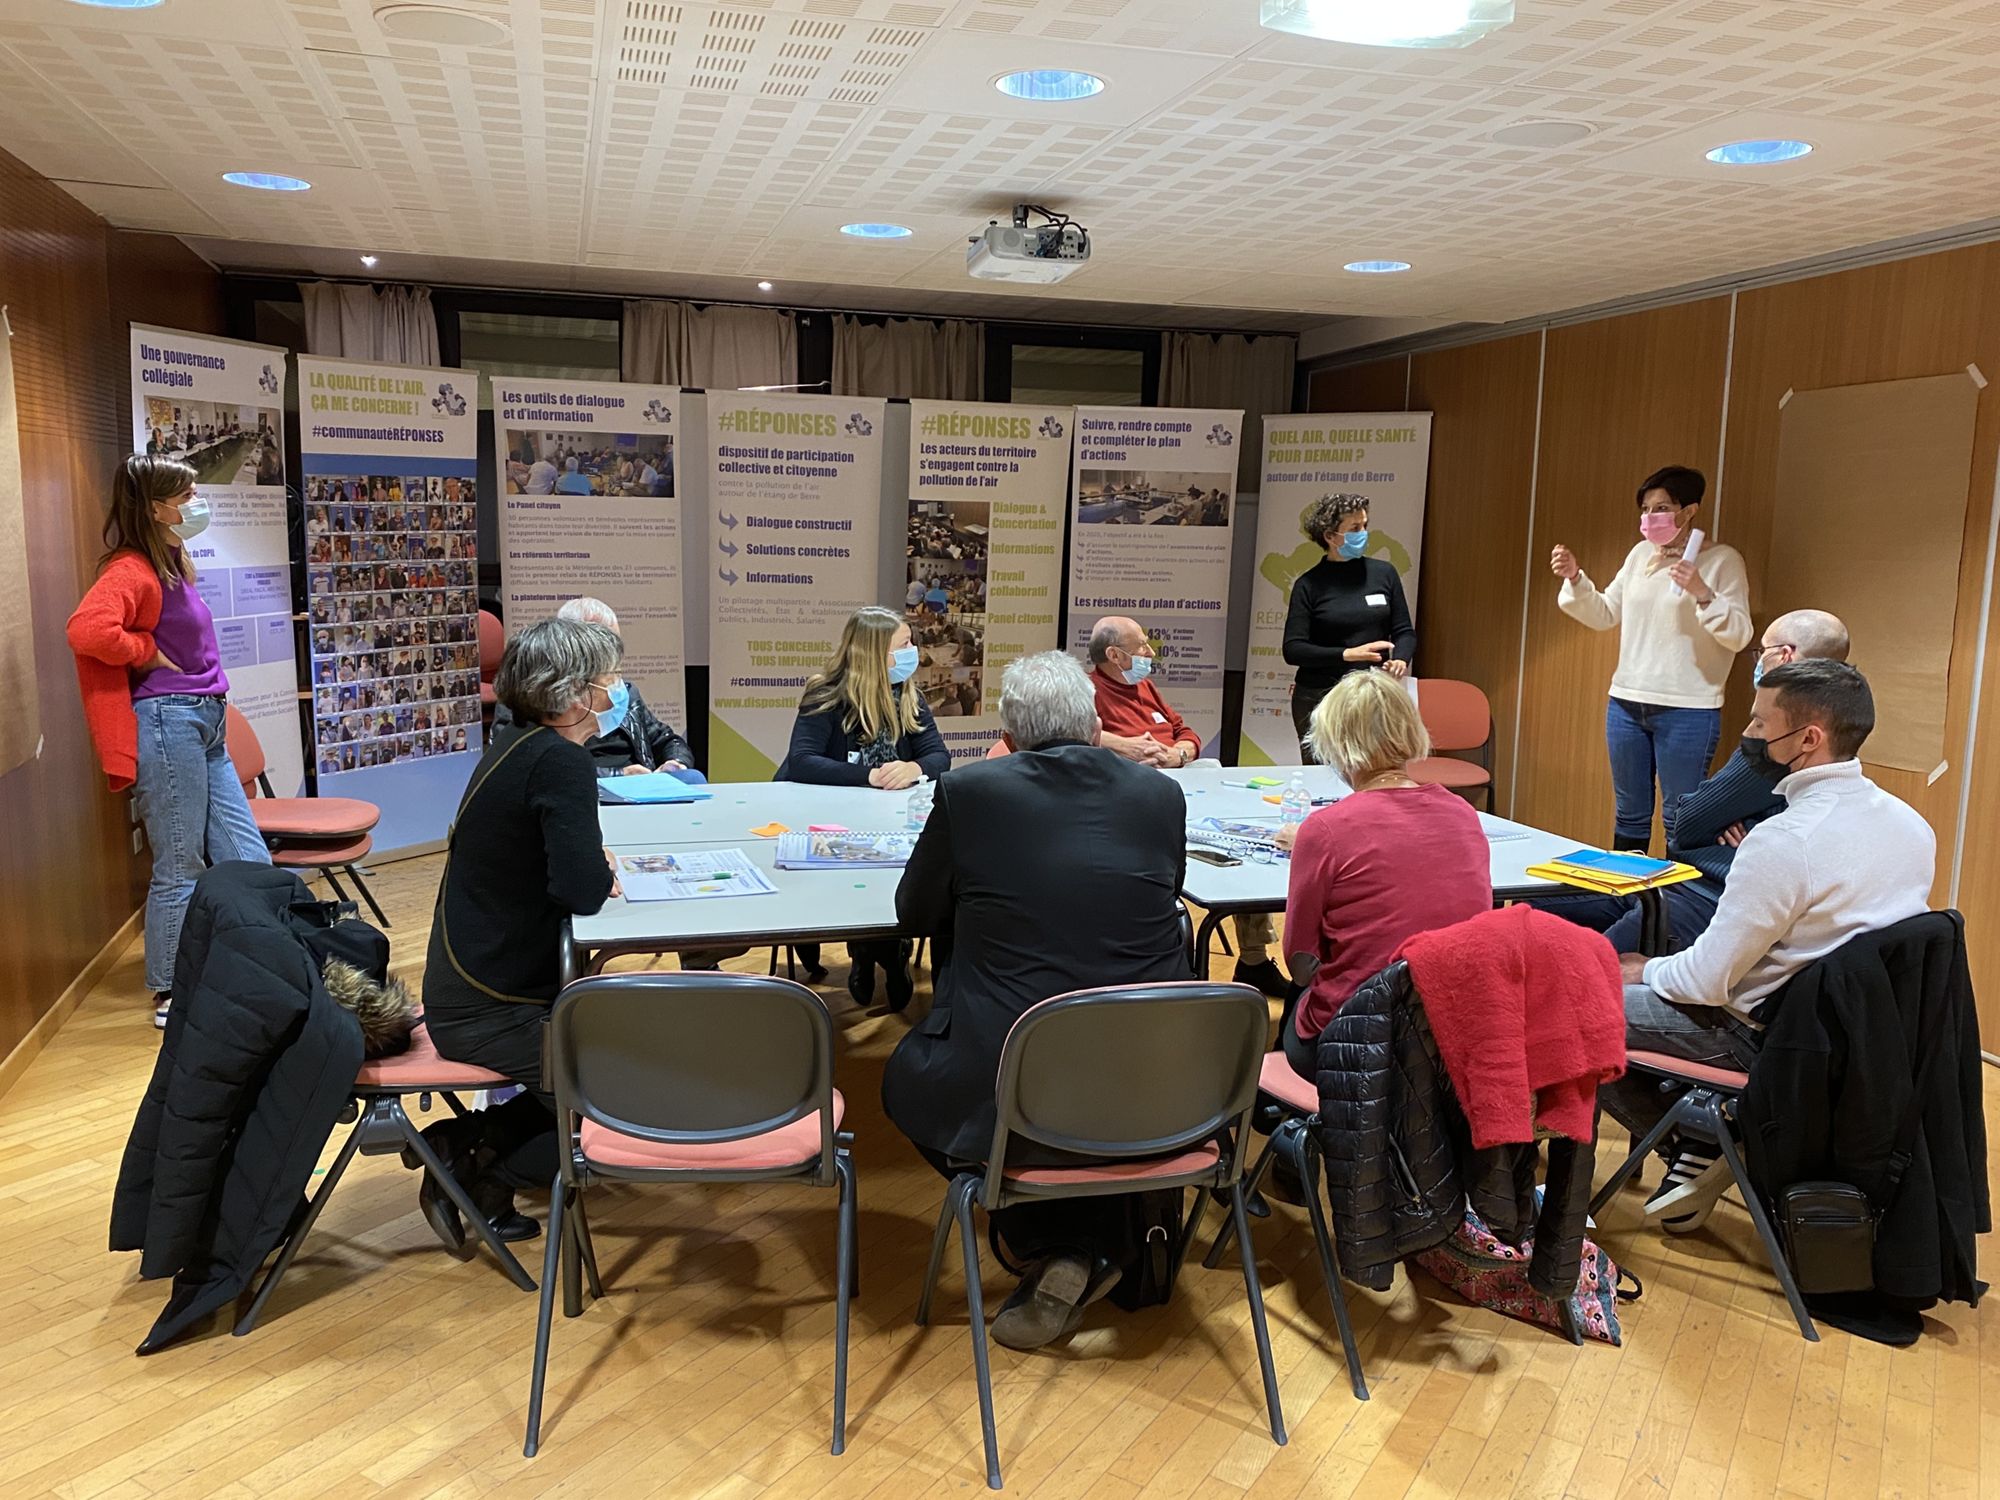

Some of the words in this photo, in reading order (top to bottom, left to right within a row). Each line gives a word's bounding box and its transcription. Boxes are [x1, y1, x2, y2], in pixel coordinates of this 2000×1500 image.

[140, 344, 161, 362] Une
[163, 350, 225, 370] gouvernance
[142, 368, 193, 387] collégiale
[310, 373, 324, 388] LA
[327, 374, 376, 392] QUALITÉ
[379, 379, 393, 393] DE
[312, 395, 328, 412] ÇA
[332, 396, 348, 411] ME
[352, 397, 413, 415] CONCERNE
[503, 391, 522, 403] Les
[525, 392, 557, 404] outils
[560, 394, 573, 406] de
[576, 394, 624, 408] dialogue
[504, 409, 515, 419] et
[518, 408, 593, 423] d'information
[718, 407, 837, 437] #RÉPONSES
[921, 411, 1031, 439] #RÉPONSES
[1082, 419, 1116, 431] Suivre,
[1118, 420, 1151, 432] rendre
[1154, 422, 1192, 433] compte
[313, 425, 443, 443] #communautéRÉPONSES
[1270, 431, 1299, 445] QUEL
[1301, 430, 1326, 445] AIR,
[1329, 429, 1373, 445] QUELLE
[1376, 427, 1416, 443] SANTÉ
[1082, 436, 1091, 445] et
[1094, 435, 1145, 448] compléter
[1147, 436, 1156, 446] le
[1159, 436, 1180, 448] plan
[719, 446, 769, 459] dispositif
[771, 449, 784, 459] de
[786, 449, 854, 463] participation
[921, 443, 937, 454] Les
[939, 445, 976, 455] acteurs
[979, 446, 990, 456] du
[992, 446, 1036, 458] territoire
[1081, 450, 1126, 461] d'actions
[1268, 449, 1301, 463] POUR
[1304, 449, 1352, 463] DEMAIN
[1356, 450, 1364, 462] ?
[719, 462, 771, 474] collective
[773, 464, 784, 475] et
[786, 465, 838, 477] citoyenne
[920, 459, 974, 471] s'engagent
[977, 462, 1008, 472] contre
[1010, 462, 1019, 472] la
[920, 475, 964, 486] pollution
[966, 476, 977, 486] de
[980, 476, 998, 487] l'air
[1267, 472, 1298, 482] autour
[1301, 472, 1312, 482] de
[1315, 472, 1348, 483] l'étang
[1351, 471, 1364, 482] de
[1366, 472, 1394, 482] Berre
[718, 480, 743, 488] contre
[747, 480, 753, 488] la
[755, 480, 791, 491] pollution
[793, 482, 802, 490] de
[804, 482, 819, 491] l'air
[747, 490, 757, 498] de
[760, 490, 786, 500] l'étang
[788, 491, 798, 499] de
[800, 492, 820, 500] Berre
[537, 502, 560, 510] citoyen
[993, 502, 1037, 515] Dialogue
[1040, 505, 1046, 513] &
[747, 516, 792, 529] Dialogue
[795, 520, 852, 531] constructif
[992, 518, 1056, 529] Concertation
[200, 549, 215, 558] COPIL
[747, 544, 795, 556] Solutions
[798, 546, 850, 558] concrètes
[991, 543, 1055, 555] Informations
[747, 572, 813, 584] Informations
[991, 570, 1025, 581] Travail
[990, 586, 1048, 597] collaboratif
[732, 598, 762, 606] pilotage
[1075, 596, 1090, 607] Les
[1093, 597, 1136, 608] résultats
[1139, 598, 1150, 608] du
[1153, 598, 1174, 609] plan
[1177, 599, 1221, 610] d'actions
[988, 613, 1016, 624] Panel
[1017, 614, 1053, 625] citoyen
[1256, 608, 1286, 624] RÉP
[1148, 628, 1171, 640] 43%
[748, 641, 773, 651] TOUS
[988, 643, 1024, 653] Actions
[1158, 646, 1179, 658] 10%
[751, 656, 776, 666] TOUS
